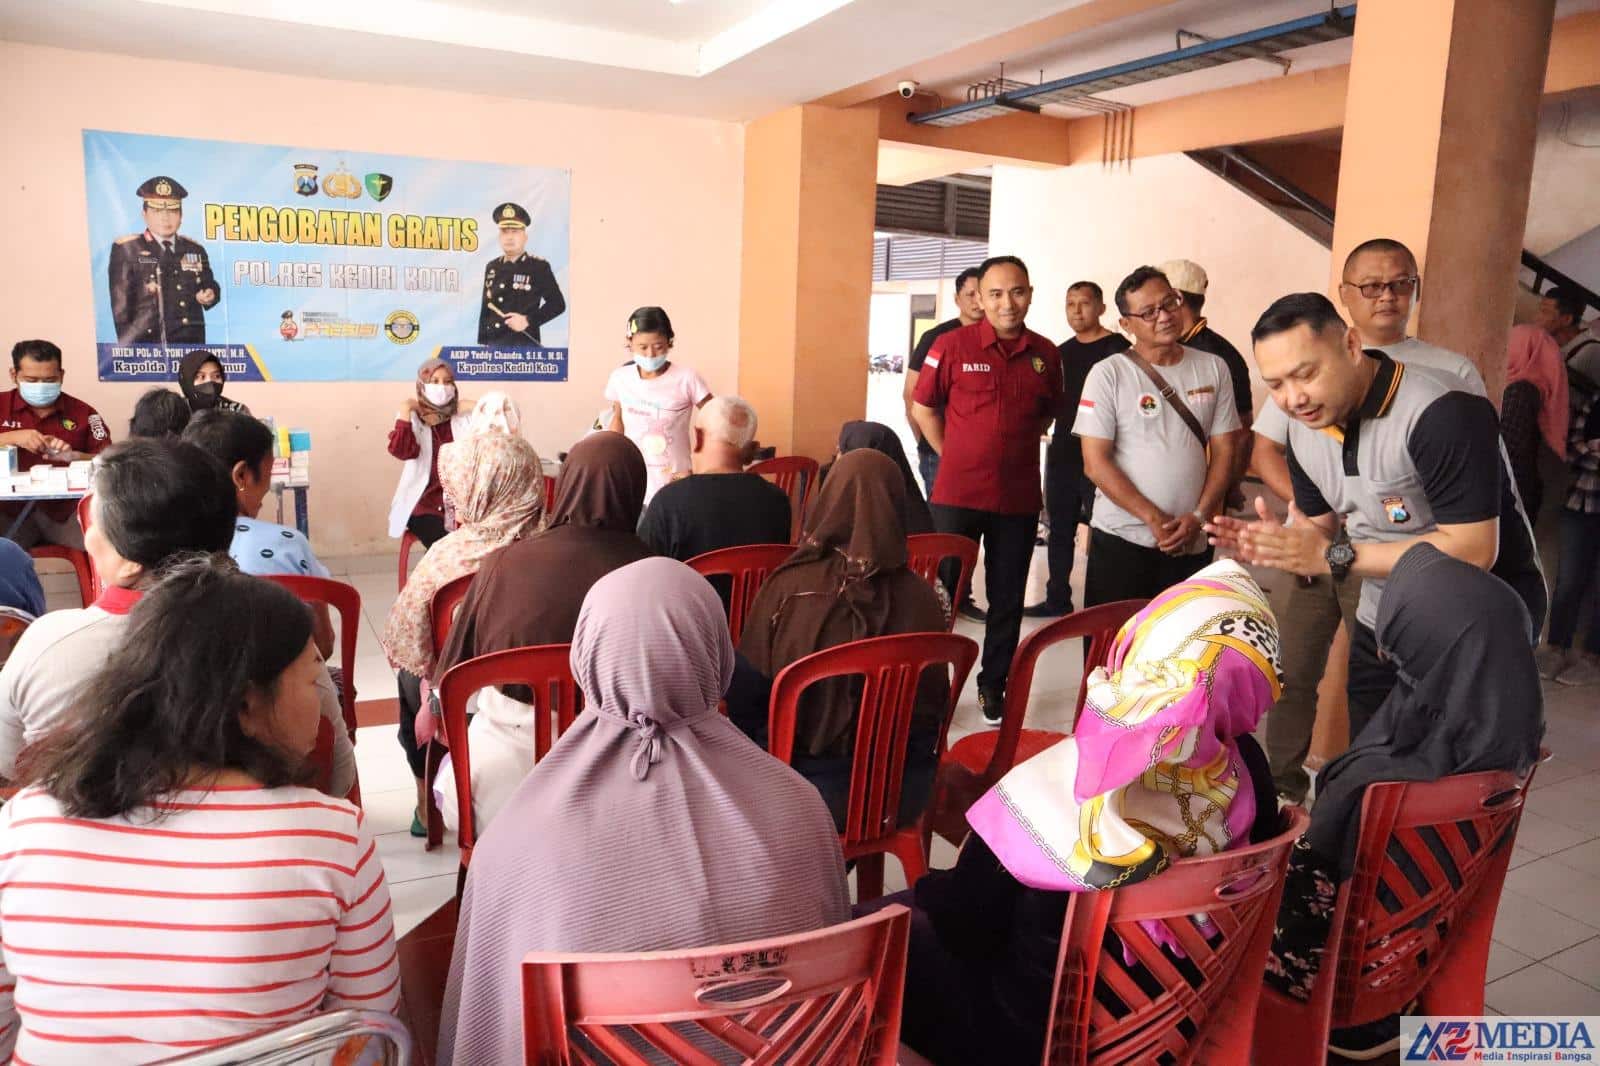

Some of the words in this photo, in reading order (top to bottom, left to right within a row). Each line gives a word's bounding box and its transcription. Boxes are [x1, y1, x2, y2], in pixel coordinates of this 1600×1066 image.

[205, 203, 383, 247] PENGOBATAN
[387, 213, 479, 252] GRATIS
[234, 260, 322, 288] POLRES
[329, 264, 396, 290] KEDIRI
[404, 266, 460, 292] KOTA
[471, 351, 492, 361] Teddy
[114, 361, 165, 375] Kapolda
[457, 361, 502, 375] Kapolres
[503, 362, 533, 373] Kediri
[535, 362, 558, 374] Kota
[962, 363, 991, 372] FARID
